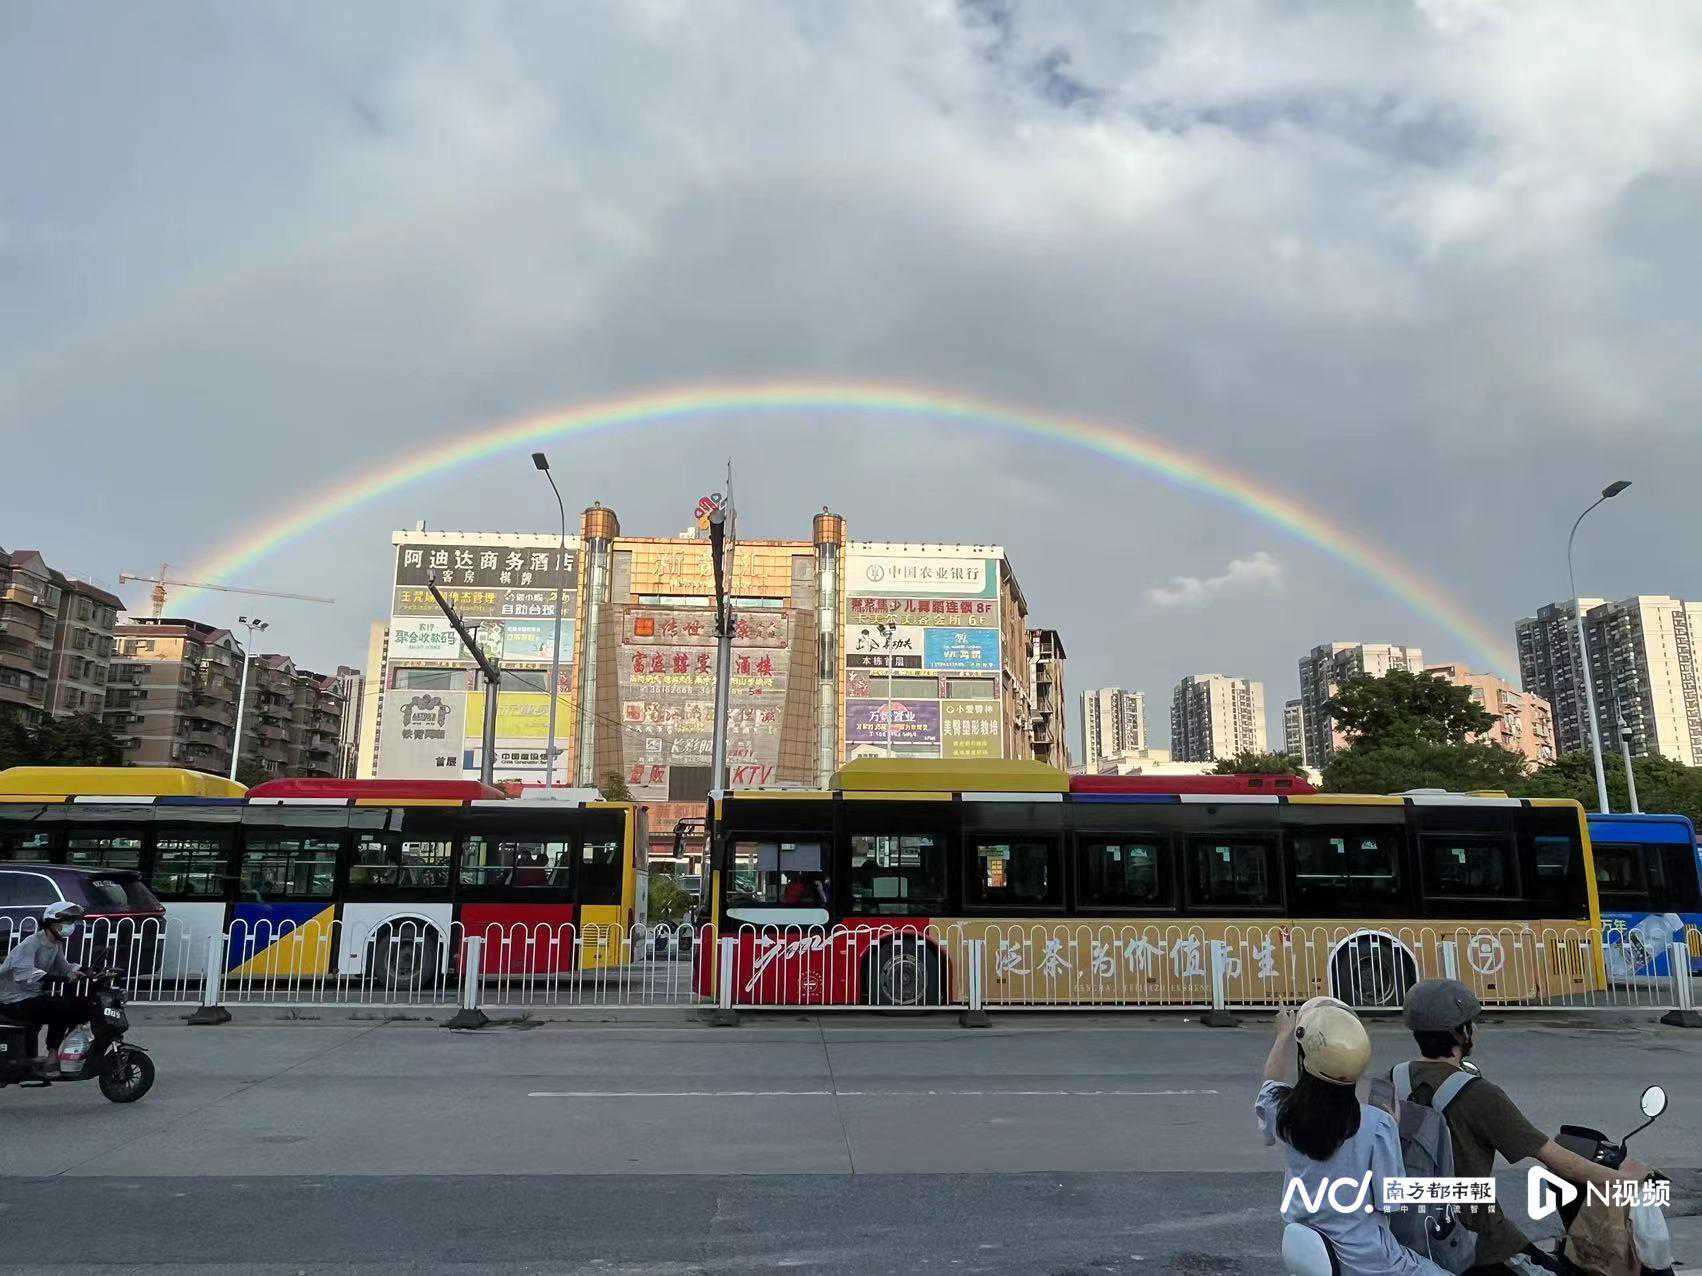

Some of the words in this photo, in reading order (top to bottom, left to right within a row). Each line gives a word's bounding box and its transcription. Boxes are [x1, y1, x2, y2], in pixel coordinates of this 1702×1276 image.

[403, 549, 574, 572] 阿迪达商务酒店
[888, 565, 980, 581] 中国农业银行
[732, 765, 773, 785] KTV
